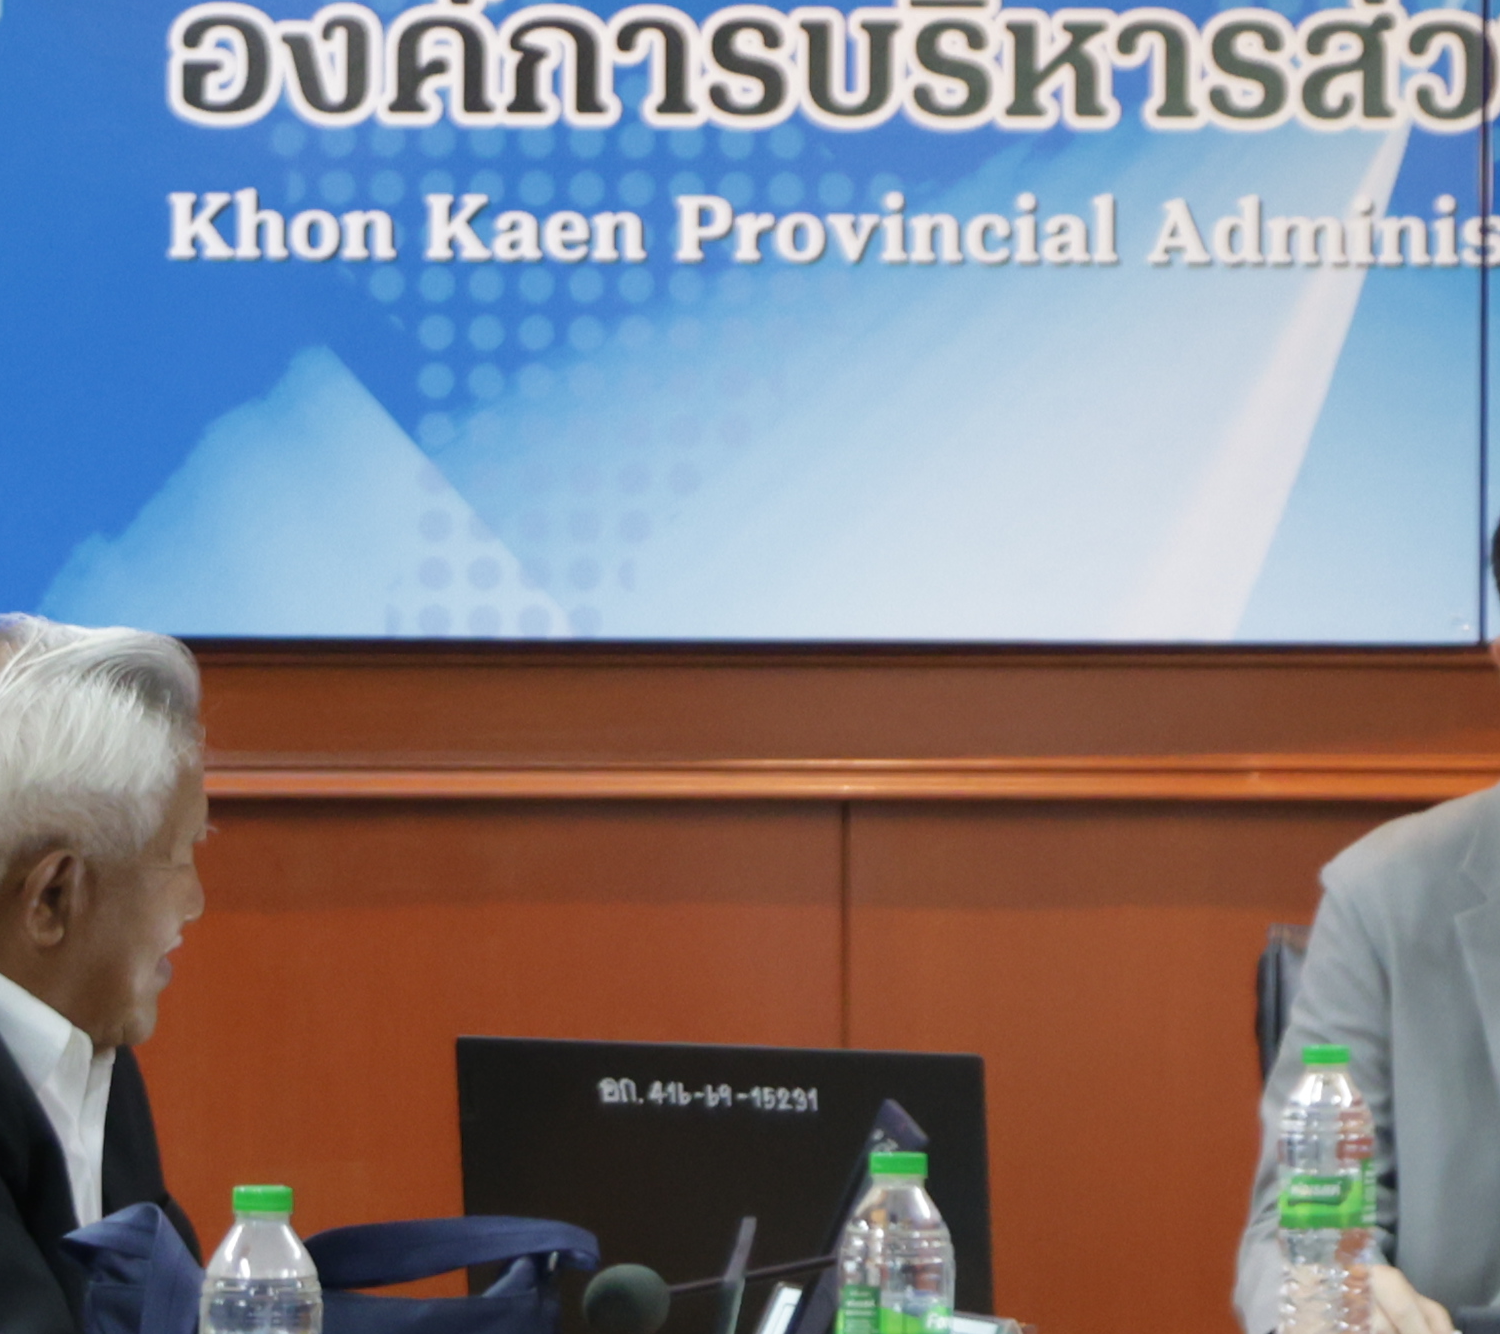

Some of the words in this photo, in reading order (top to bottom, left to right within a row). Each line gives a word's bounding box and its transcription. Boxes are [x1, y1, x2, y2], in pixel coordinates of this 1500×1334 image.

[165, 187, 398, 264] Khon
[424, 189, 648, 264] Kaen
[674, 187, 1119, 264] Provincial
